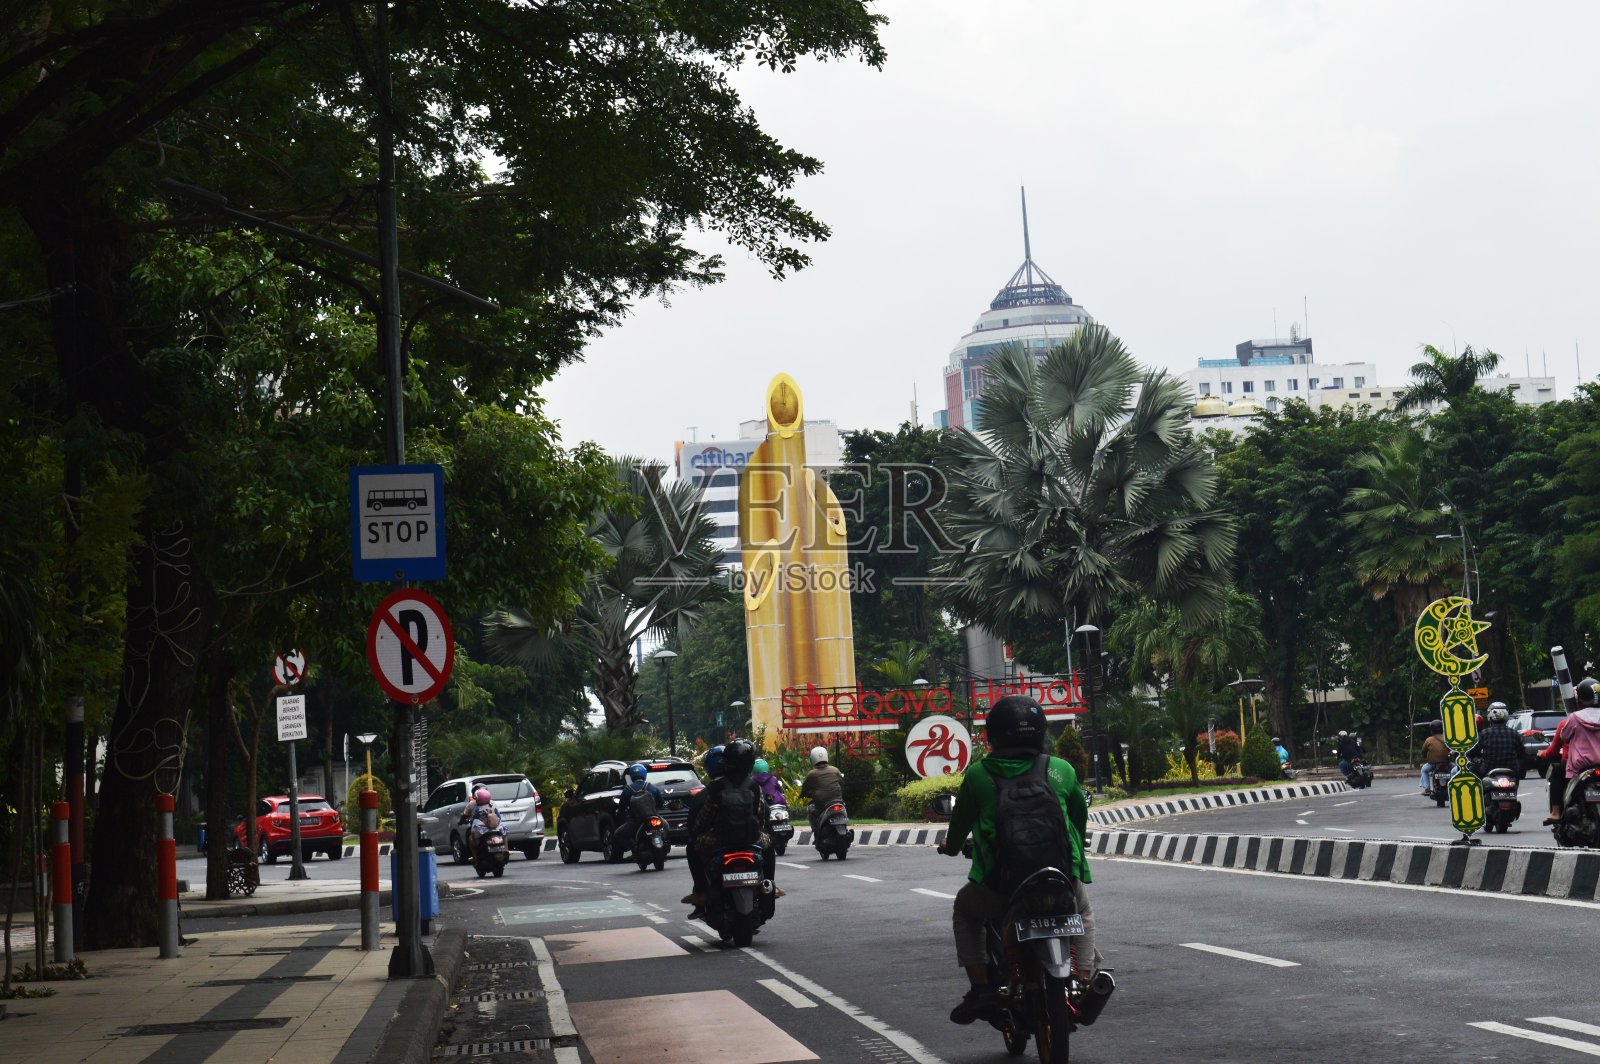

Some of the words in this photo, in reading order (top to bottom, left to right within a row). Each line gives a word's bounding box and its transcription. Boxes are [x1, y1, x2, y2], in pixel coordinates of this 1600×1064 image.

[368, 520, 428, 544] STOP
[399, 609, 428, 686] P
[781, 681, 953, 719] Surabaya
[1018, 922, 1025, 931] L
